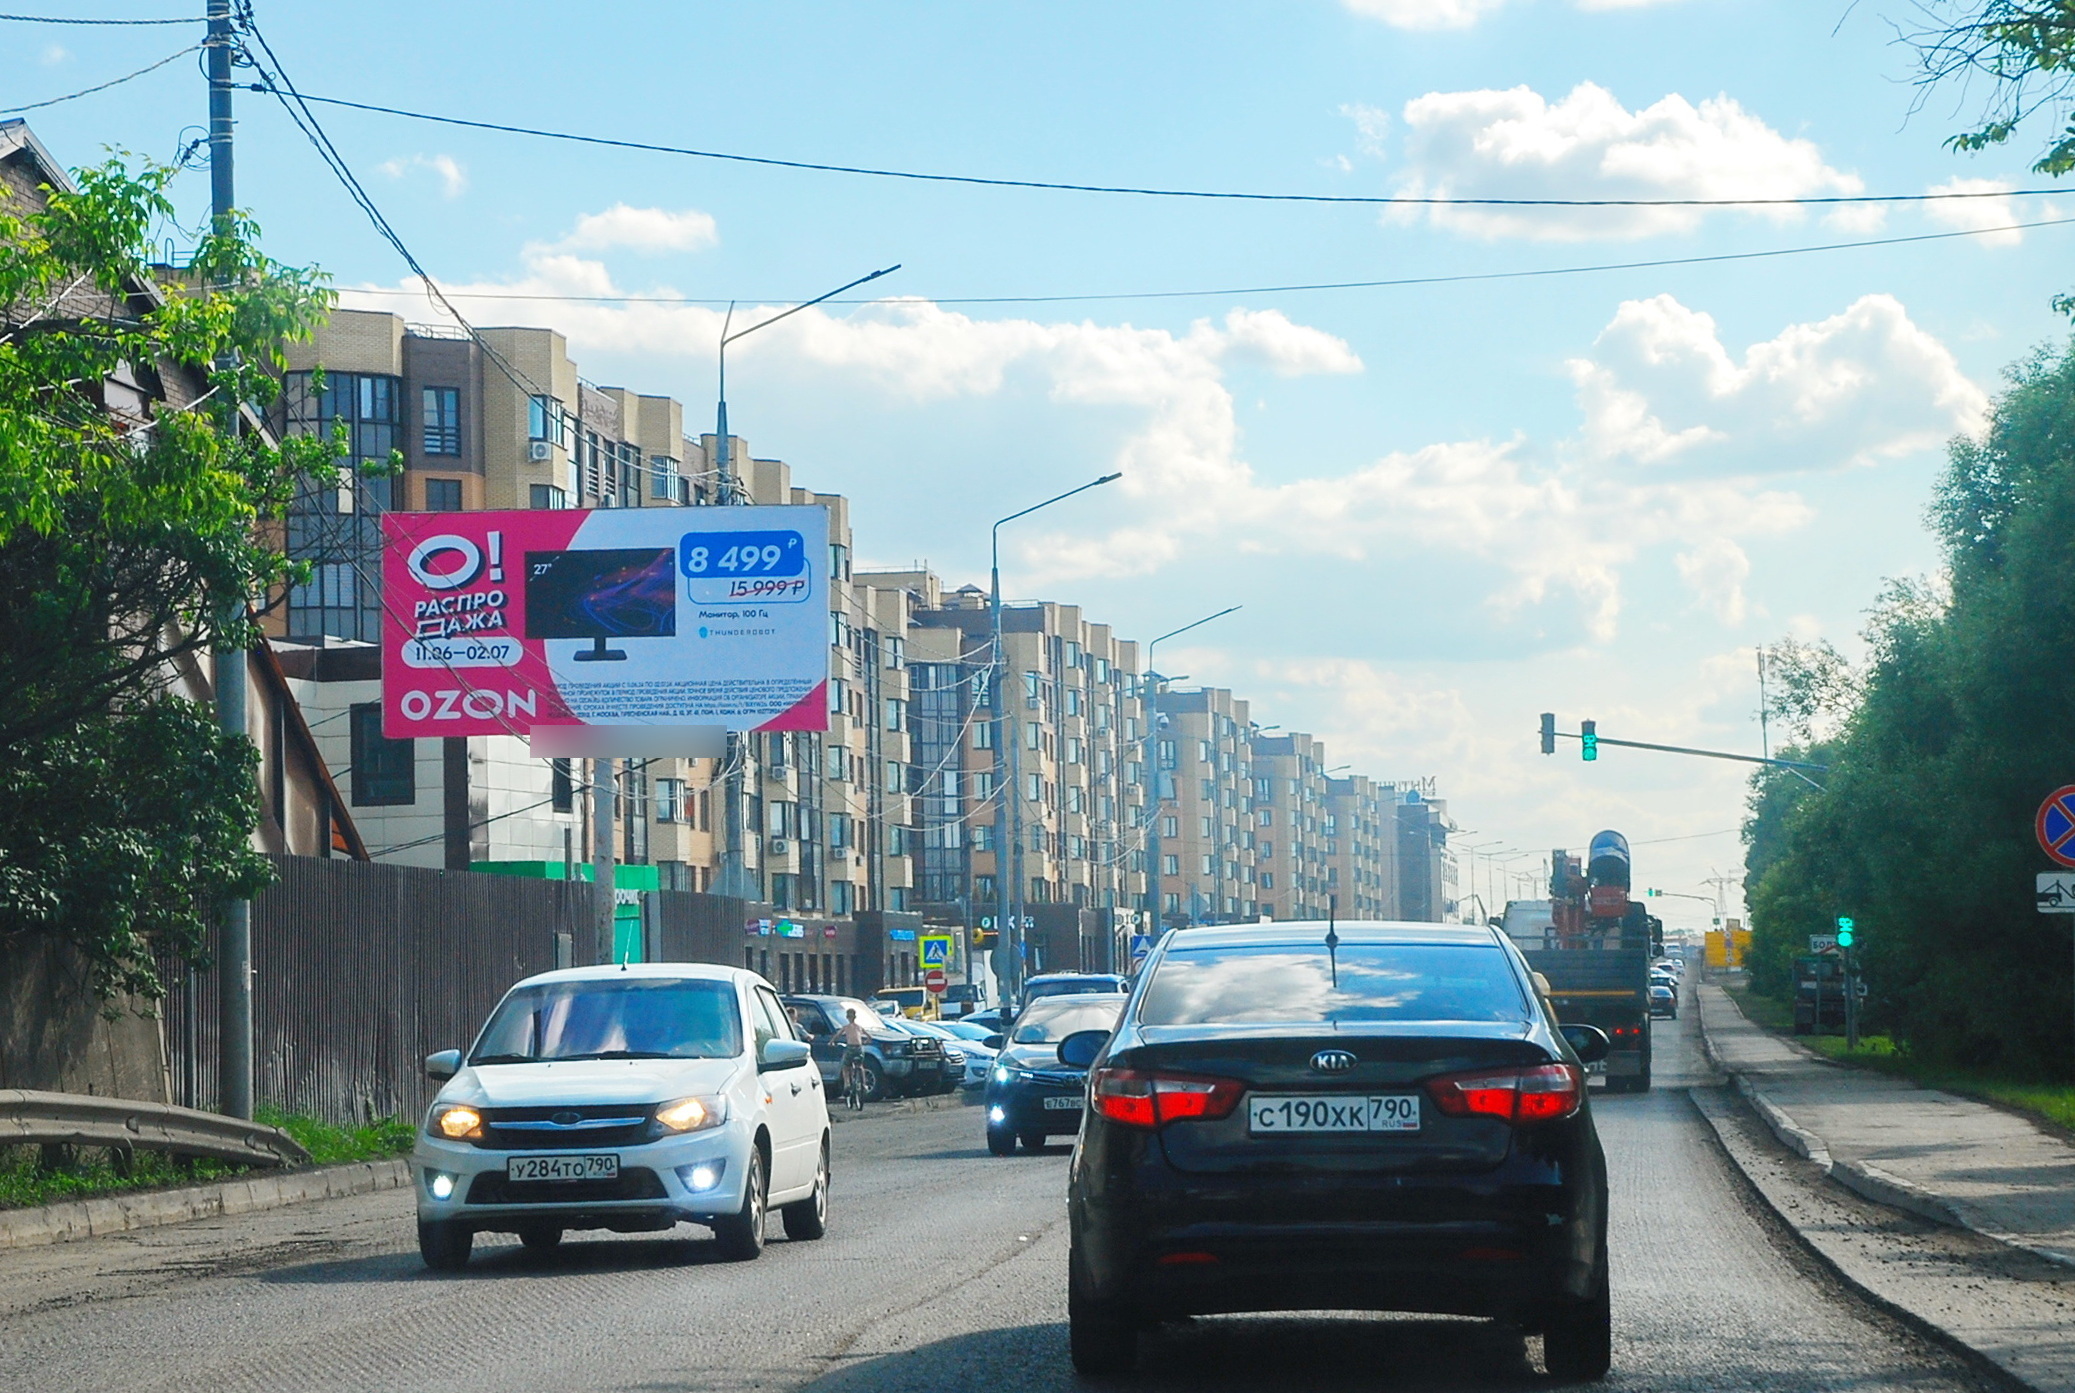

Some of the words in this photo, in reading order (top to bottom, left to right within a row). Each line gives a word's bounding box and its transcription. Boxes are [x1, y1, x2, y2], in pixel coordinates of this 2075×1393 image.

[407, 530, 503, 589] О!
[688, 546, 709, 573] 8
[717, 545, 781, 572] 499
[730, 581, 748, 596] 15
[753, 580, 787, 596] 999
[414, 590, 505, 618] РАСПРО
[698, 610, 740, 620] Монитор,
[743, 610, 756, 618] 100
[758, 609, 768, 619] Гц
[414, 610, 504, 638] ДАЖА
[709, 628, 776, 636] THUNDEROBOT
[401, 689, 537, 721] OZON
[1316, 1054, 1351, 1070] KIA
[1259, 1101, 1364, 1128] С190ХК
[1370, 1099, 1412, 1119] 790
[1382, 1120, 1402, 1128] RUS
[516, 1159, 585, 1178] У284ТО
[586, 1157, 613, 1171] 790
